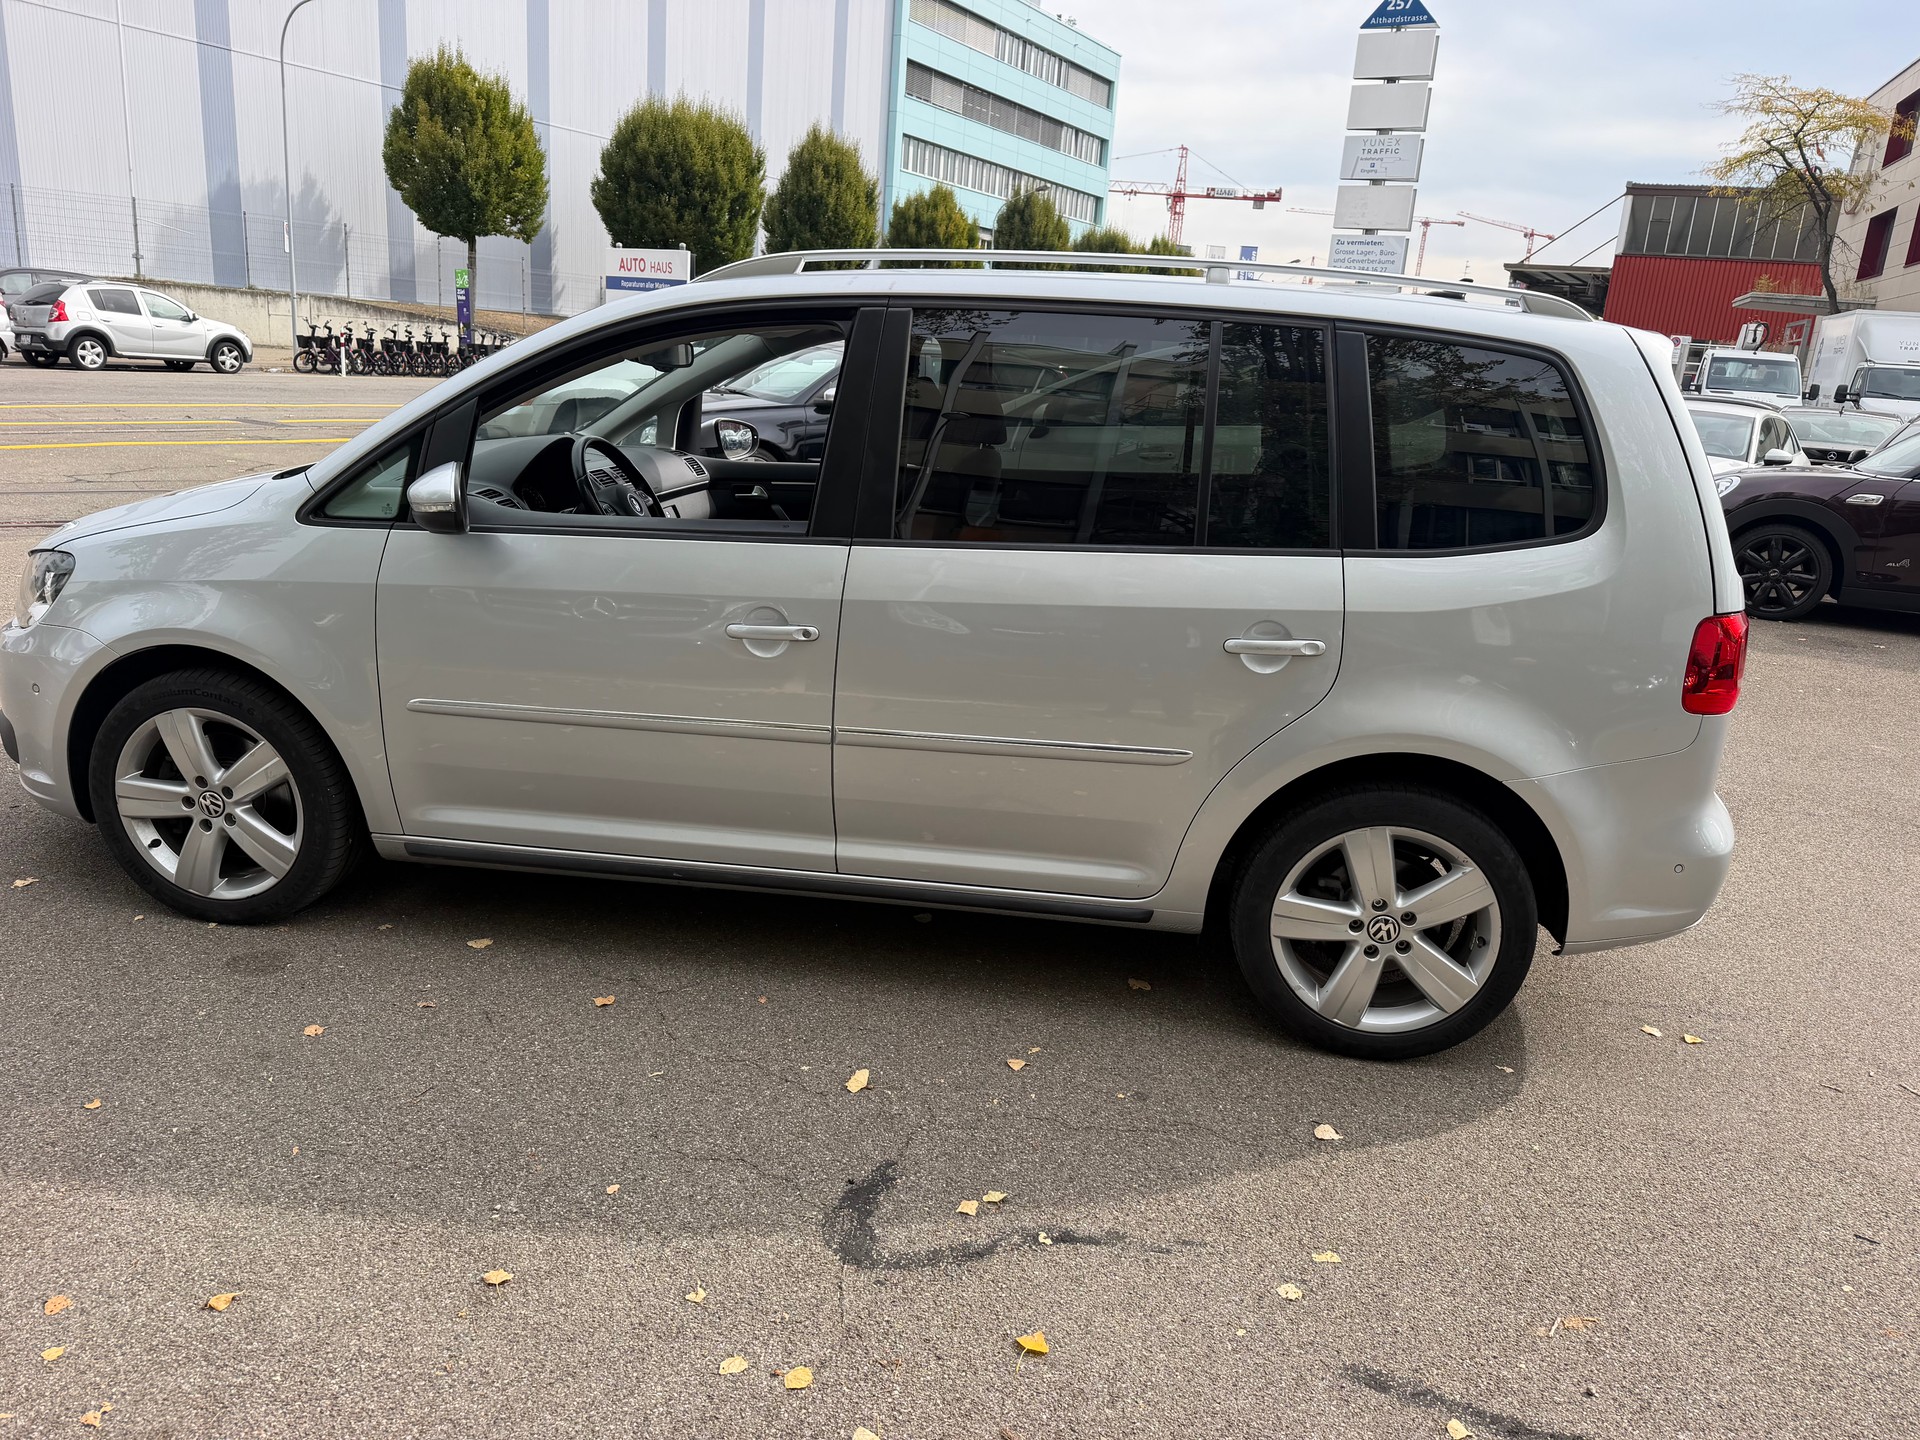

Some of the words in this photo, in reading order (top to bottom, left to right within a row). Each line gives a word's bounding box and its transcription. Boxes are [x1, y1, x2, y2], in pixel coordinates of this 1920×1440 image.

[1386, 0, 1414, 11] 257
[1370, 15, 1428, 24] Althardstrasse
[1362, 137, 1401, 147] YUNEX
[1361, 147, 1400, 155] TRAFFIC
[1334, 248, 1355, 256] Grosse
[619, 257, 646, 273] AUTO
[650, 261, 673, 274] HAUS
[1346, 257, 1396, 265] Gewerberäume
